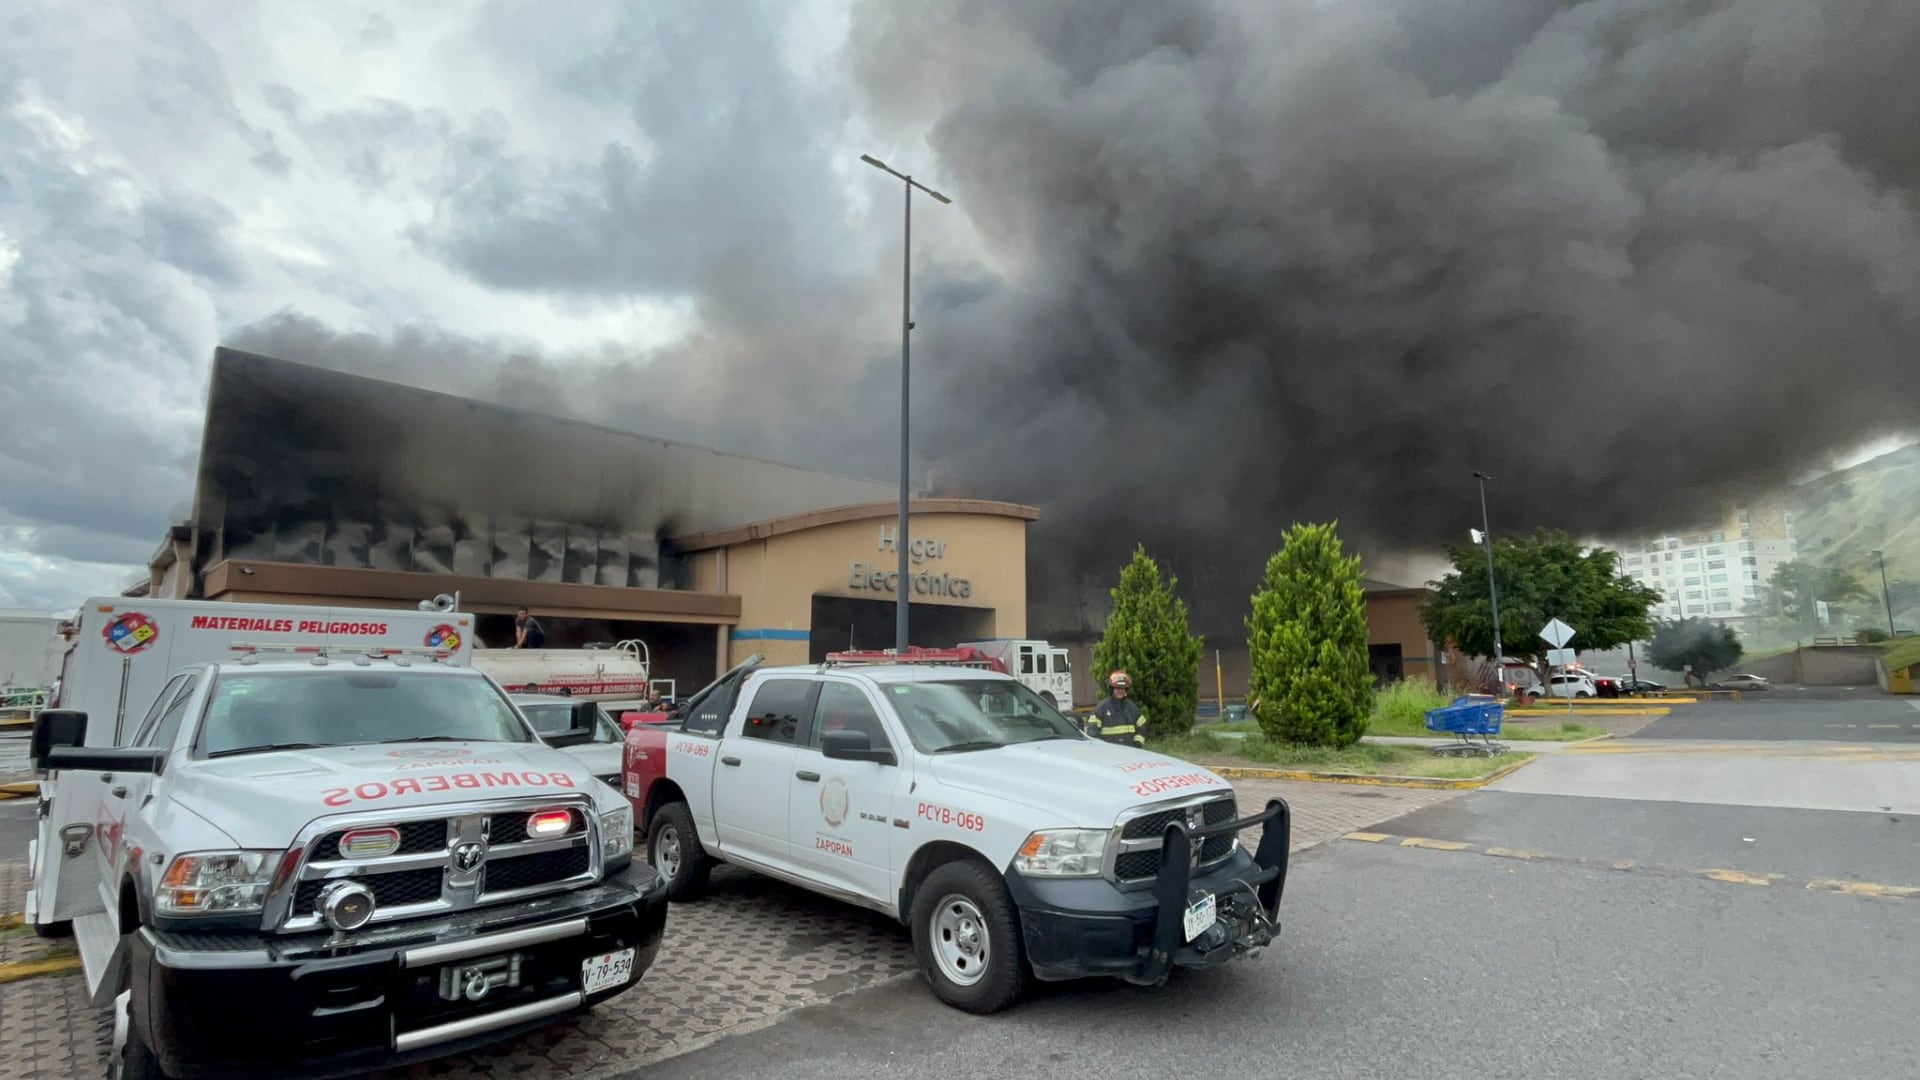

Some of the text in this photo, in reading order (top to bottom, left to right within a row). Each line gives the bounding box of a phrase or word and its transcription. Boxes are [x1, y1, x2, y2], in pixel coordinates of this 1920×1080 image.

[849, 560, 972, 599] Elecrónica
[191, 615, 388, 635] MATERIALES PELIGROSOS
[591, 684, 603, 694] DE
[603, 683, 644, 694] BOMBEROS
[917, 802, 985, 832] PCYB-069
[815, 837, 853, 857] ZAPOPAN
